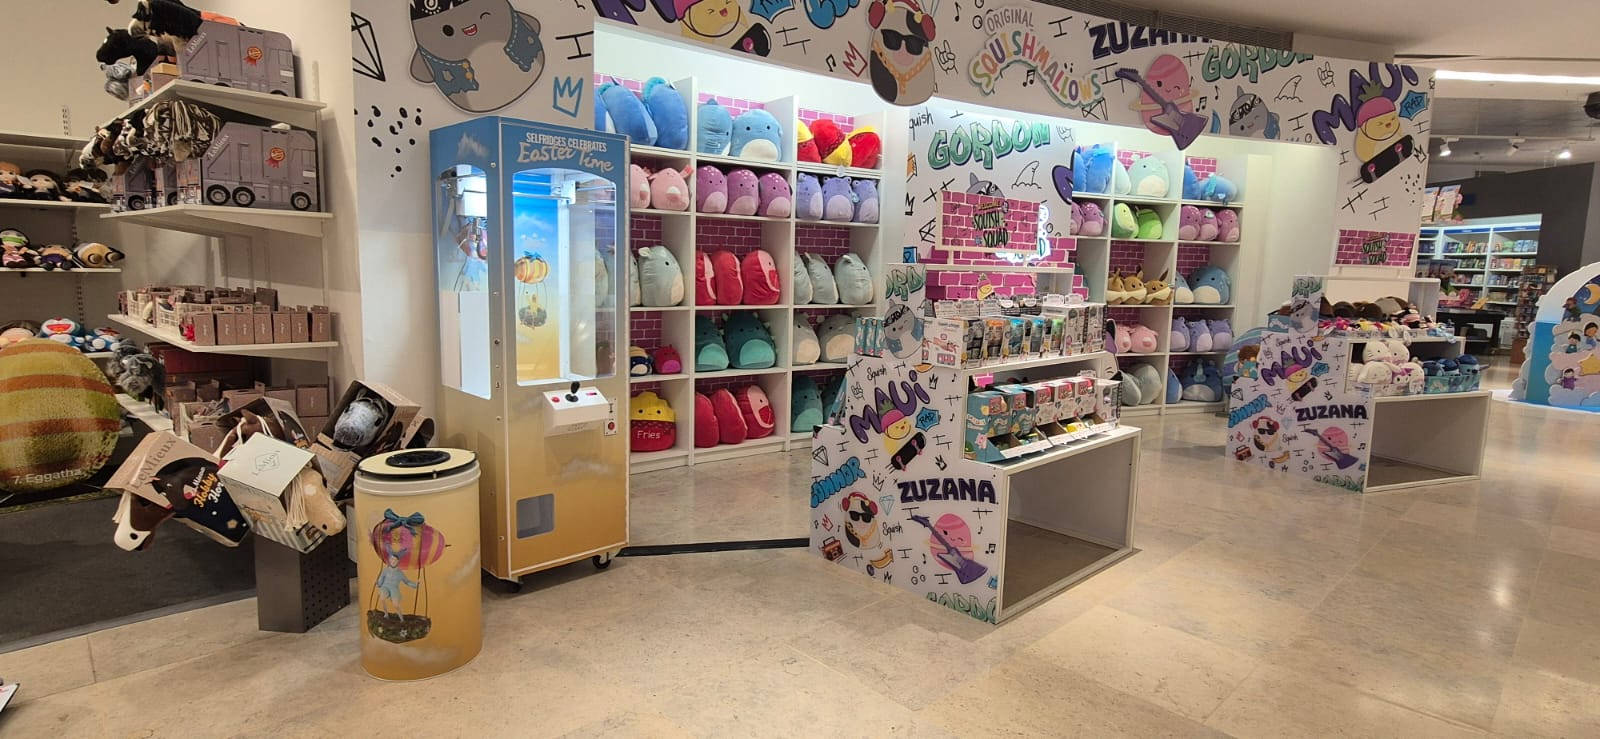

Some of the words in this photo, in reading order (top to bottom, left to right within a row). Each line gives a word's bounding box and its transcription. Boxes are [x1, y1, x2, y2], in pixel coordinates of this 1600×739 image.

[986, 8, 1034, 33] ORIGINAL
[972, 30, 1101, 101] SQUISHMALLOWS
[526, 132, 567, 148] SELFRIDGES
[567, 137, 608, 153] CELEBRATES
[928, 119, 1051, 170] GORDON
[578, 147, 615, 173] Time
[866, 364, 888, 386] Squish
[918, 411, 936, 428] RAD
[1294, 404, 1368, 422] ZUZANA
[636, 429, 662, 441] Fries
[897, 477, 998, 504] ZUZANA
[882, 521, 904, 542] Squish
